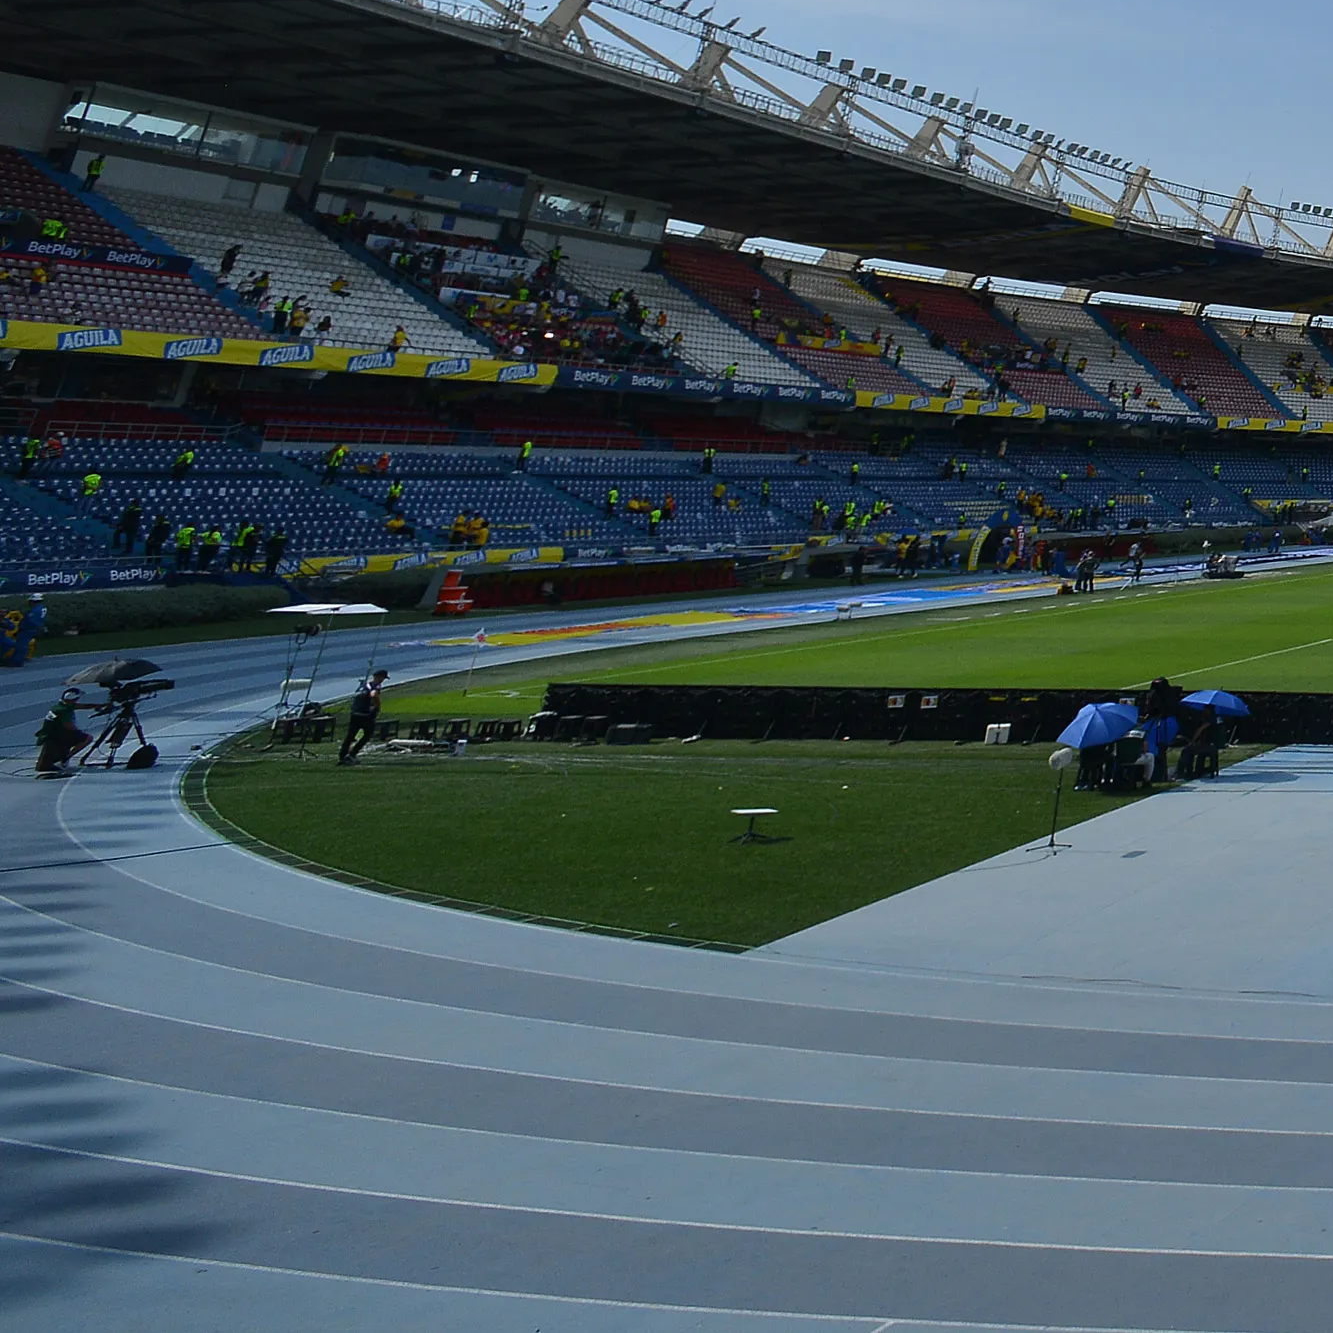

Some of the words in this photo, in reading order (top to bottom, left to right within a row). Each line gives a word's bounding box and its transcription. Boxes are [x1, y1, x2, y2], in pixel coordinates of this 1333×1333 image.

[27, 240, 81, 259] BetPlay
[107, 251, 156, 268] BetPlay
[60, 329, 120, 350] AGUILA
[166, 338, 220, 359] AGUILA
[262, 346, 312, 365] AGUILA
[349, 352, 394, 371] AGUILA
[573, 371, 611, 386] BetPlay
[631, 375, 666, 390] BetPlay
[684, 379, 717, 393] BetPlay
[732, 383, 763, 397] BetPlay
[778, 387, 807, 400] BetPlay
[820, 389, 847, 402] BetPlay
[28, 571, 80, 586] BetPlay
[110, 568, 156, 582] BetPlay
